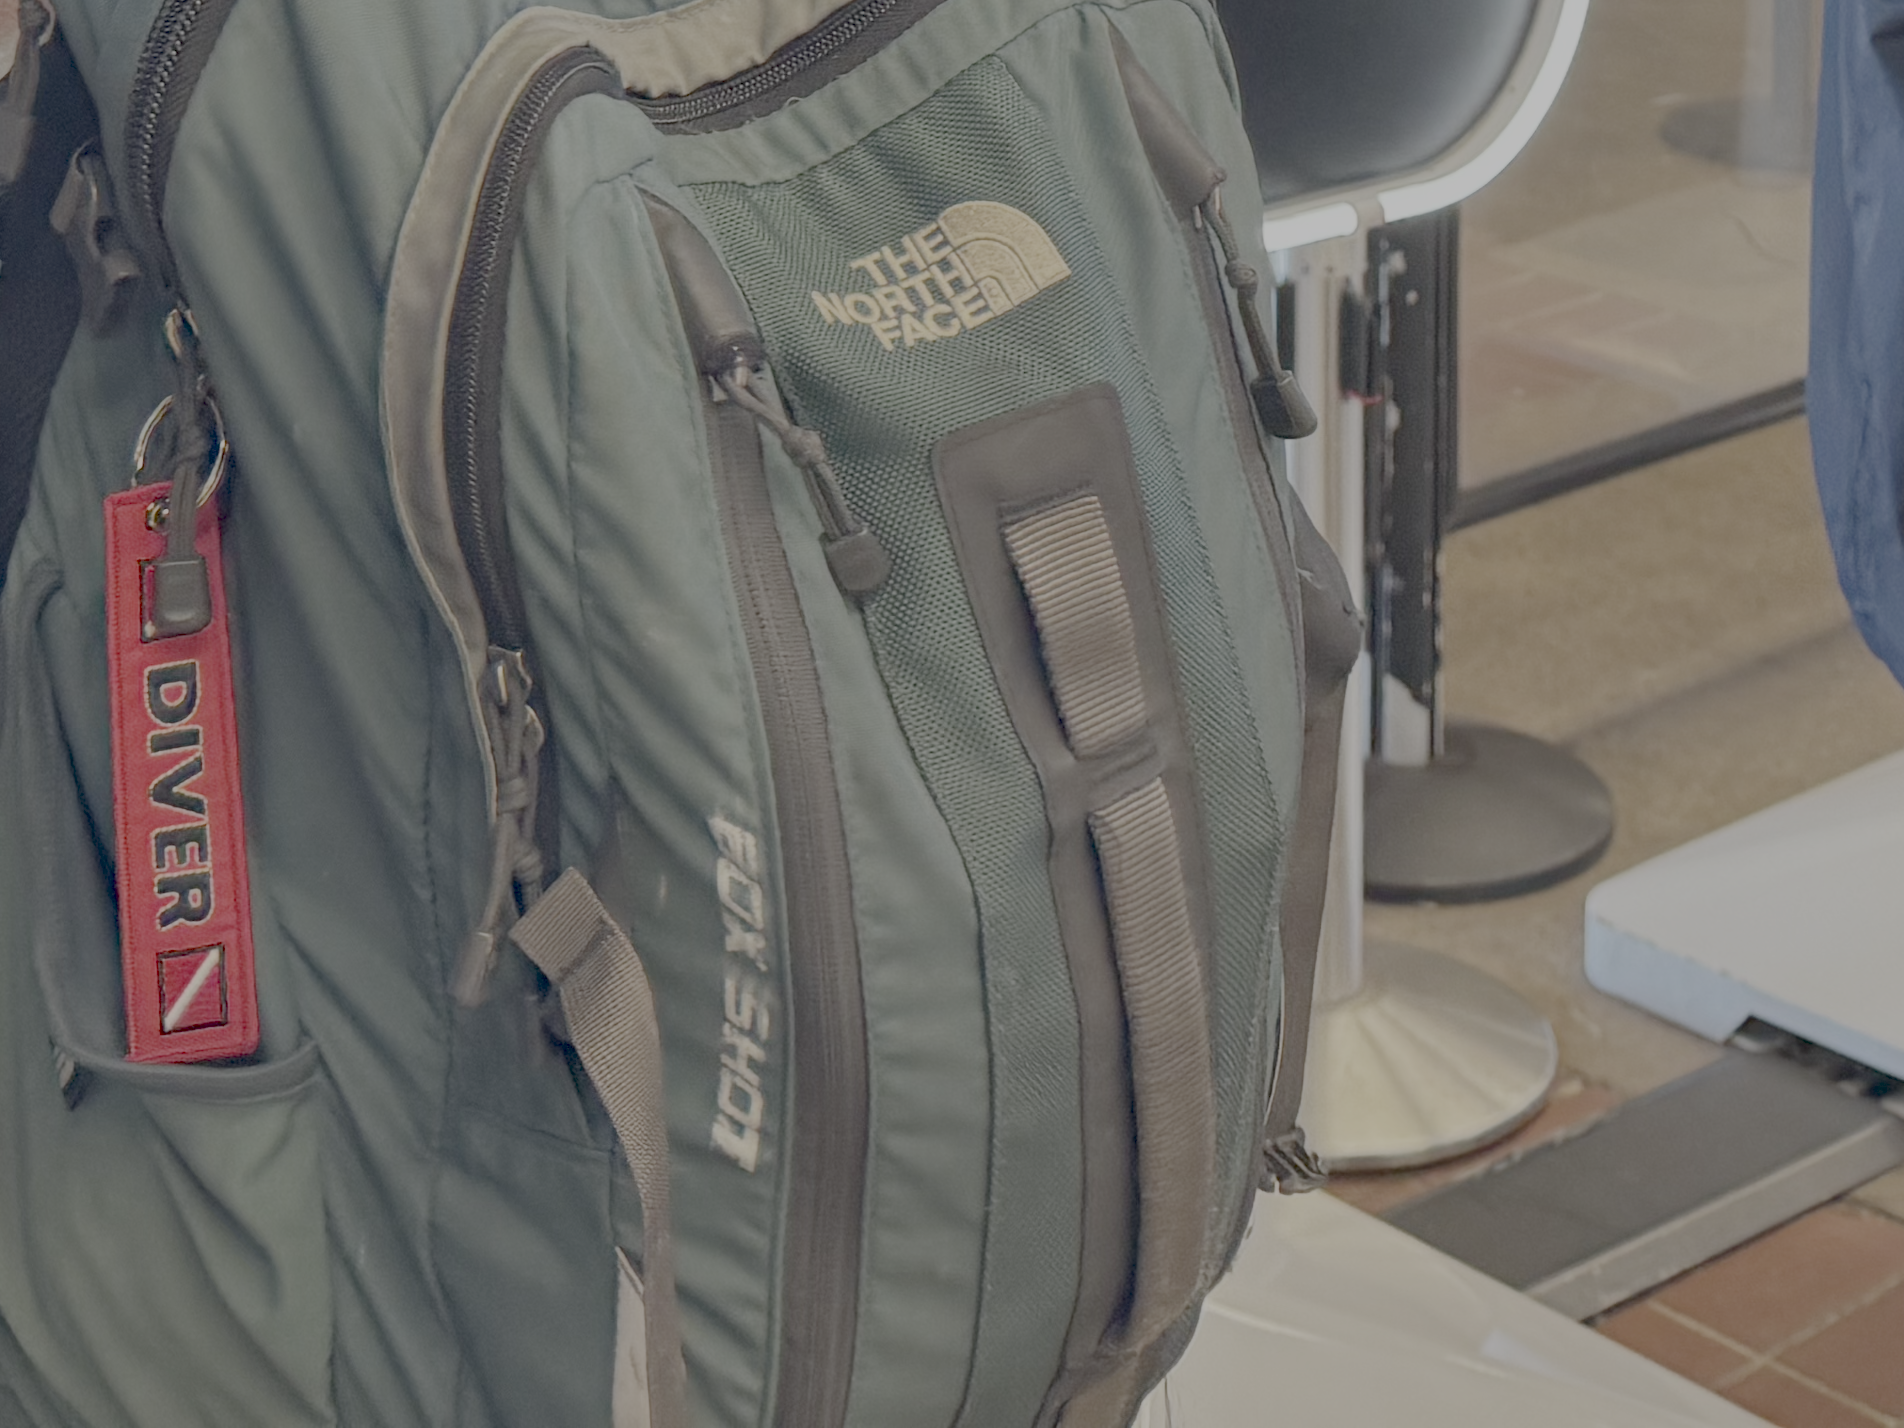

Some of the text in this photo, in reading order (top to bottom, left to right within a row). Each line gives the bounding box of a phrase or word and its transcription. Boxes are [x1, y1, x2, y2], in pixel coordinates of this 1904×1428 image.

[811, 251, 979, 326] NORTH
[850, 221, 952, 287] THE
[870, 287, 994, 352] FACE
[142, 657, 214, 930] DIVER
[706, 816, 770, 1174] FOX SHOT
